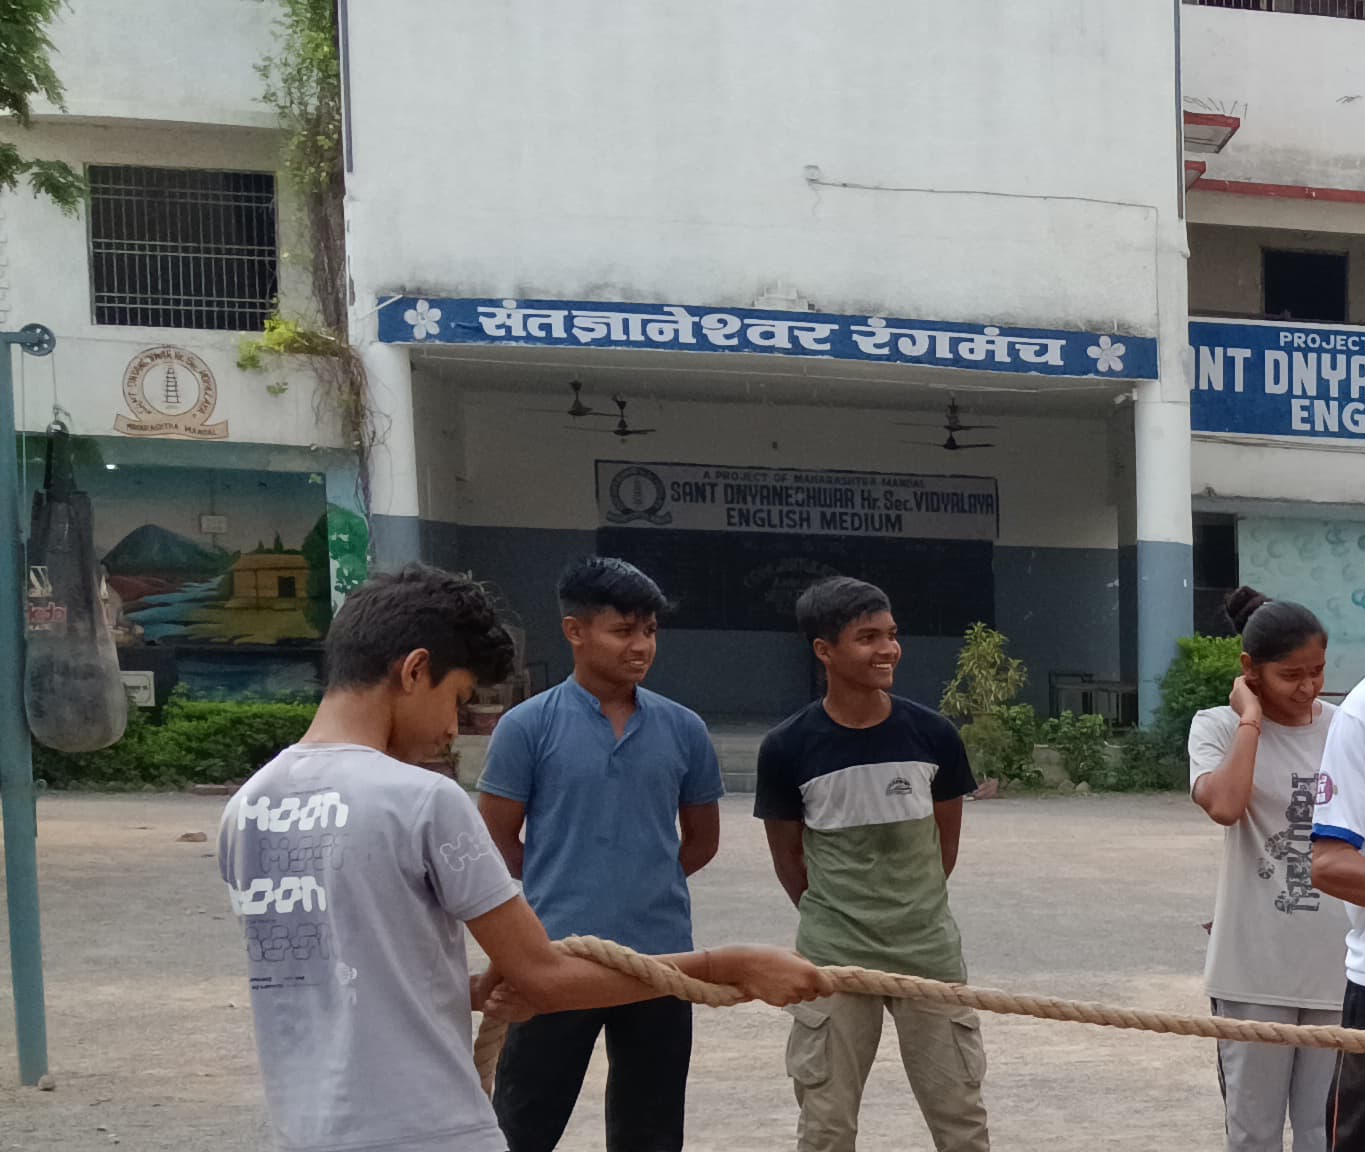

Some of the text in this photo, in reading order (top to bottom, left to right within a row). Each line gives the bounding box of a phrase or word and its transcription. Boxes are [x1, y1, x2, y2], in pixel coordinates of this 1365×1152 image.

[850, 318, 1066, 365] रंगमंच
[715, 471, 769, 483] PROJECT
[670, 480, 719, 504] SANT
[913, 491, 995, 515] VIDYALAYA
[726, 508, 903, 533] ENGLISH MEDIUM
